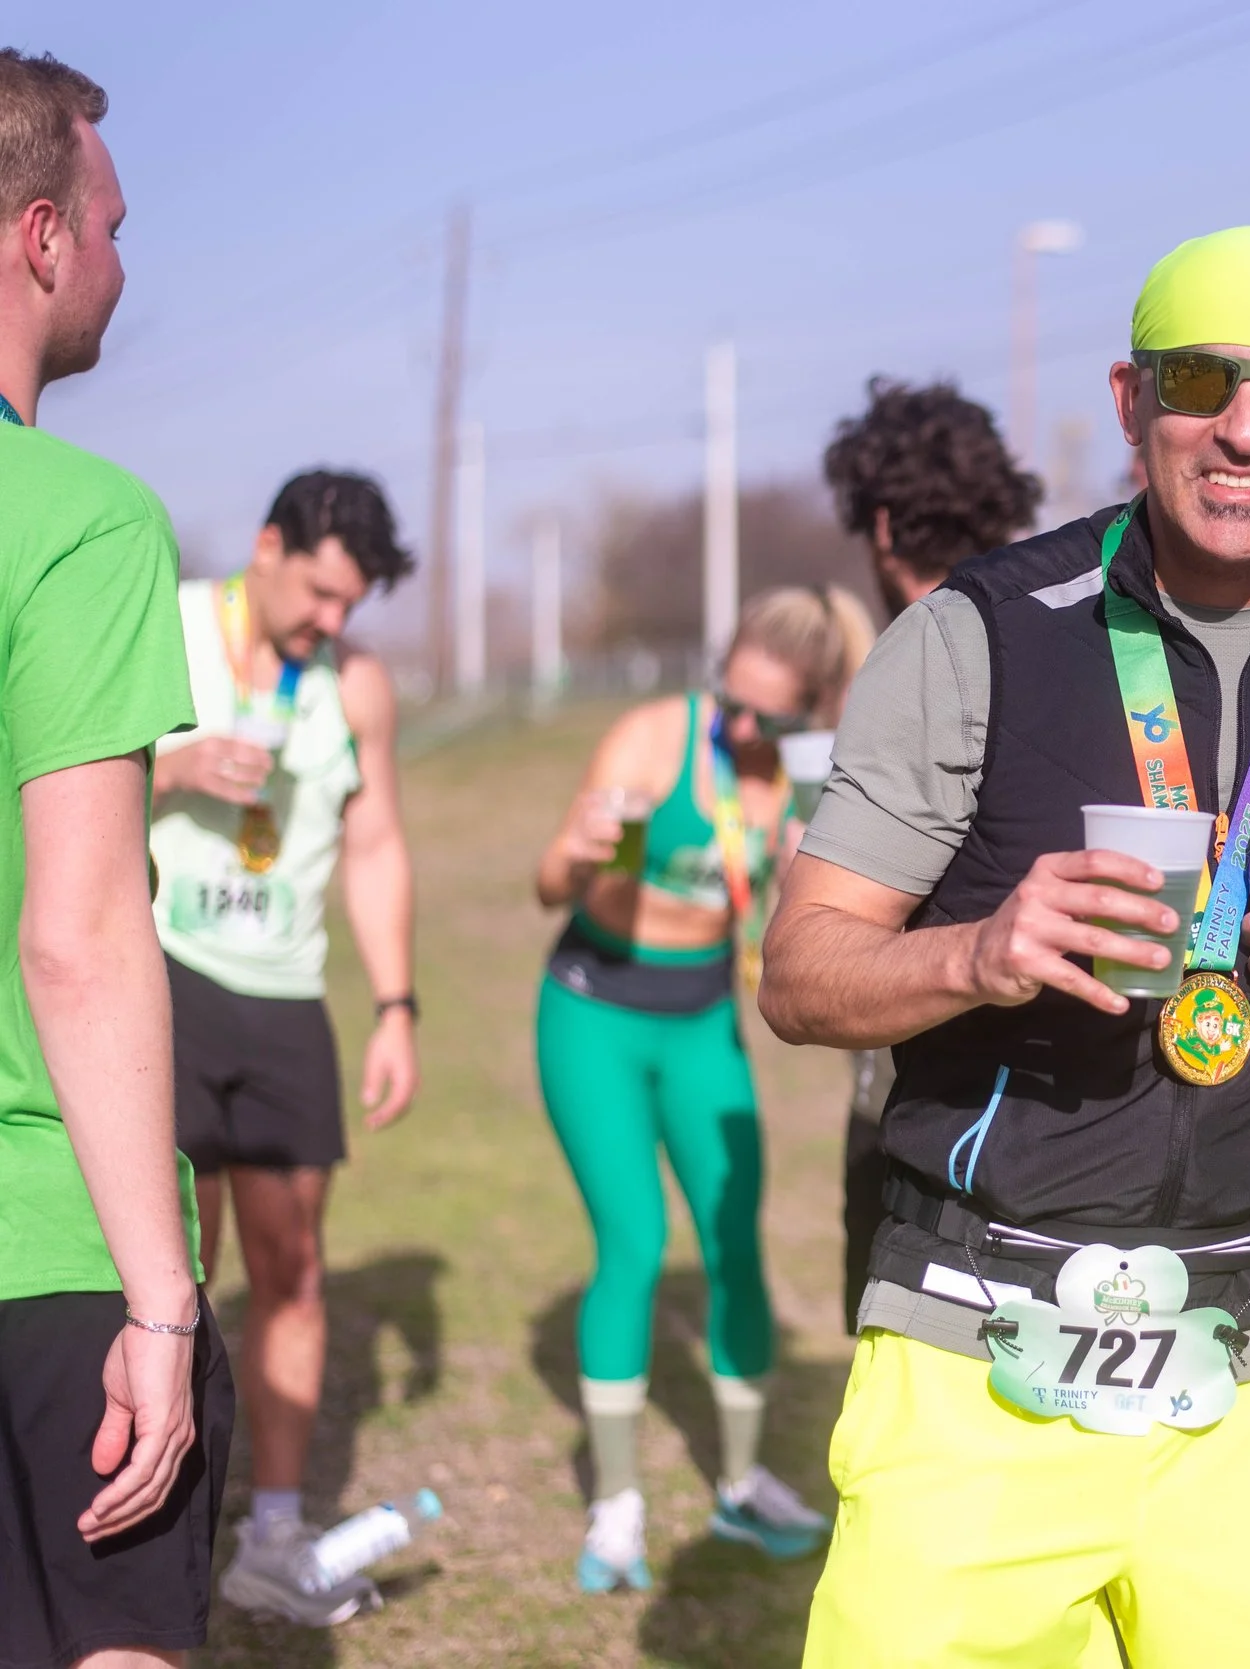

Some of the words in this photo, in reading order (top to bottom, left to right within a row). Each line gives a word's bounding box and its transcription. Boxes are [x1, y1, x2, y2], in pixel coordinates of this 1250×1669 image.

[1146, 758, 1171, 809] SHAM
[1203, 883, 1230, 952] TRINITY
[1217, 906, 1237, 959] FALLS
[1225, 1021, 1243, 1037] 5K
[1058, 1325, 1176, 1389] 727
[1053, 1388, 1098, 1400] TRINITY
[1054, 1398, 1087, 1410] FALLS
